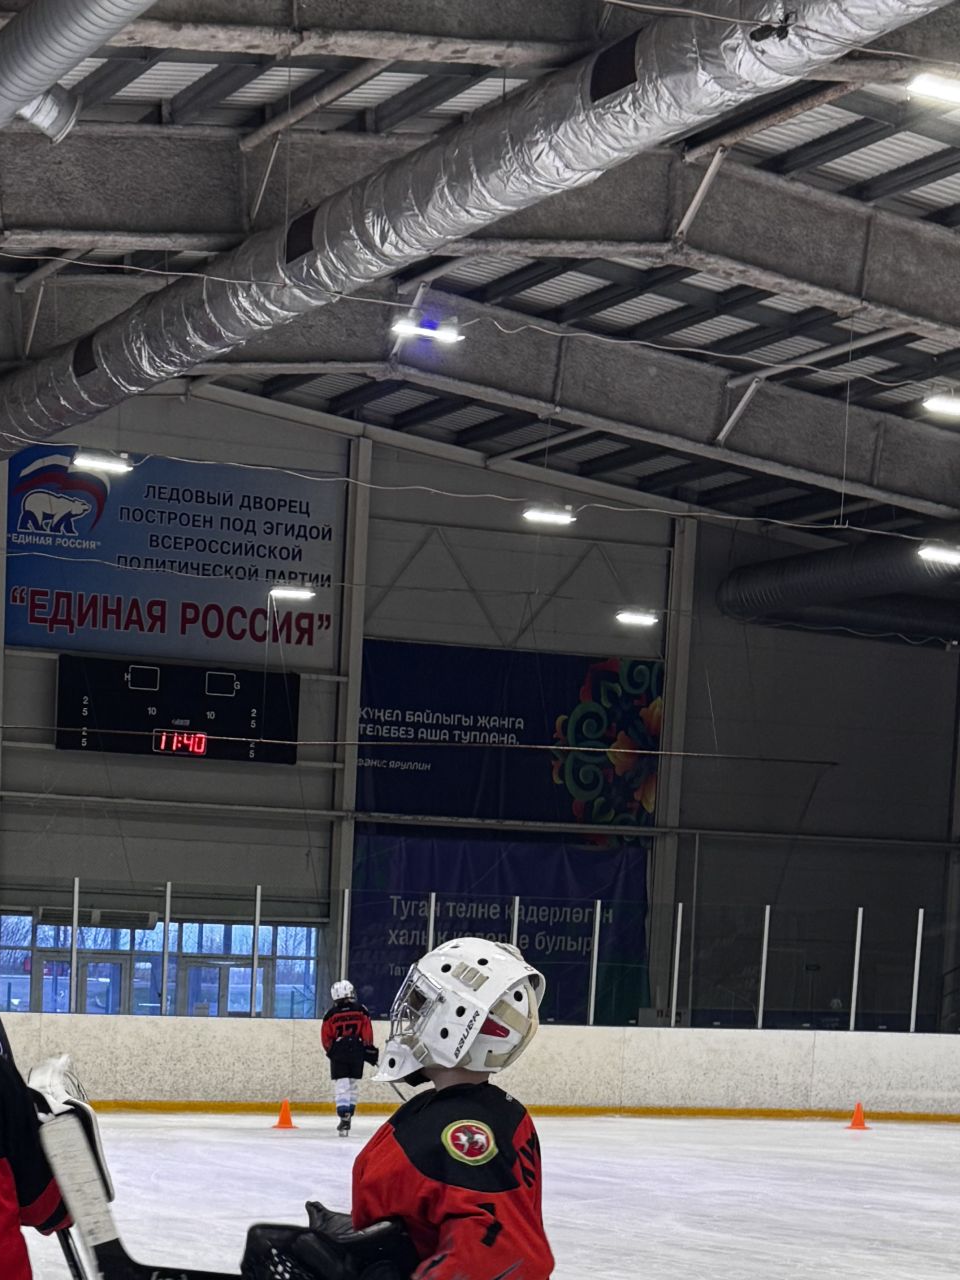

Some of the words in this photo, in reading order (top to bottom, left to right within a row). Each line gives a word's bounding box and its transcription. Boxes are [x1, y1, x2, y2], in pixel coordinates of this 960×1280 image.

[144, 484, 234, 507] ЛЕДОВЫЙ
[239, 494, 310, 517] ДВОРЕЦ
[119, 506, 213, 529] ПОСТРОЕН
[220, 516, 257, 536] ПОД
[263, 520, 333, 542] ЭГИДОЙ
[149, 533, 303, 562] ВСЕРОССИЙСКОЙ
[117, 555, 259, 582] ПОЛИТИЧЕСКОЙ
[265, 568, 332, 588] ПАРТИИ
[358, 722, 415, 739] ТЕЛЕБЕЗ
[417, 728, 450, 742] АША
[404, 709, 474, 727] БАЙЛЫГЫ
[159, 731, 206, 752] 11:40
[446, 901, 501, 920] телне
[505, 903, 614, 926] кадерләгн
[534, 930, 593, 957] булыр
[453, 1009, 481, 1060] BAUER
